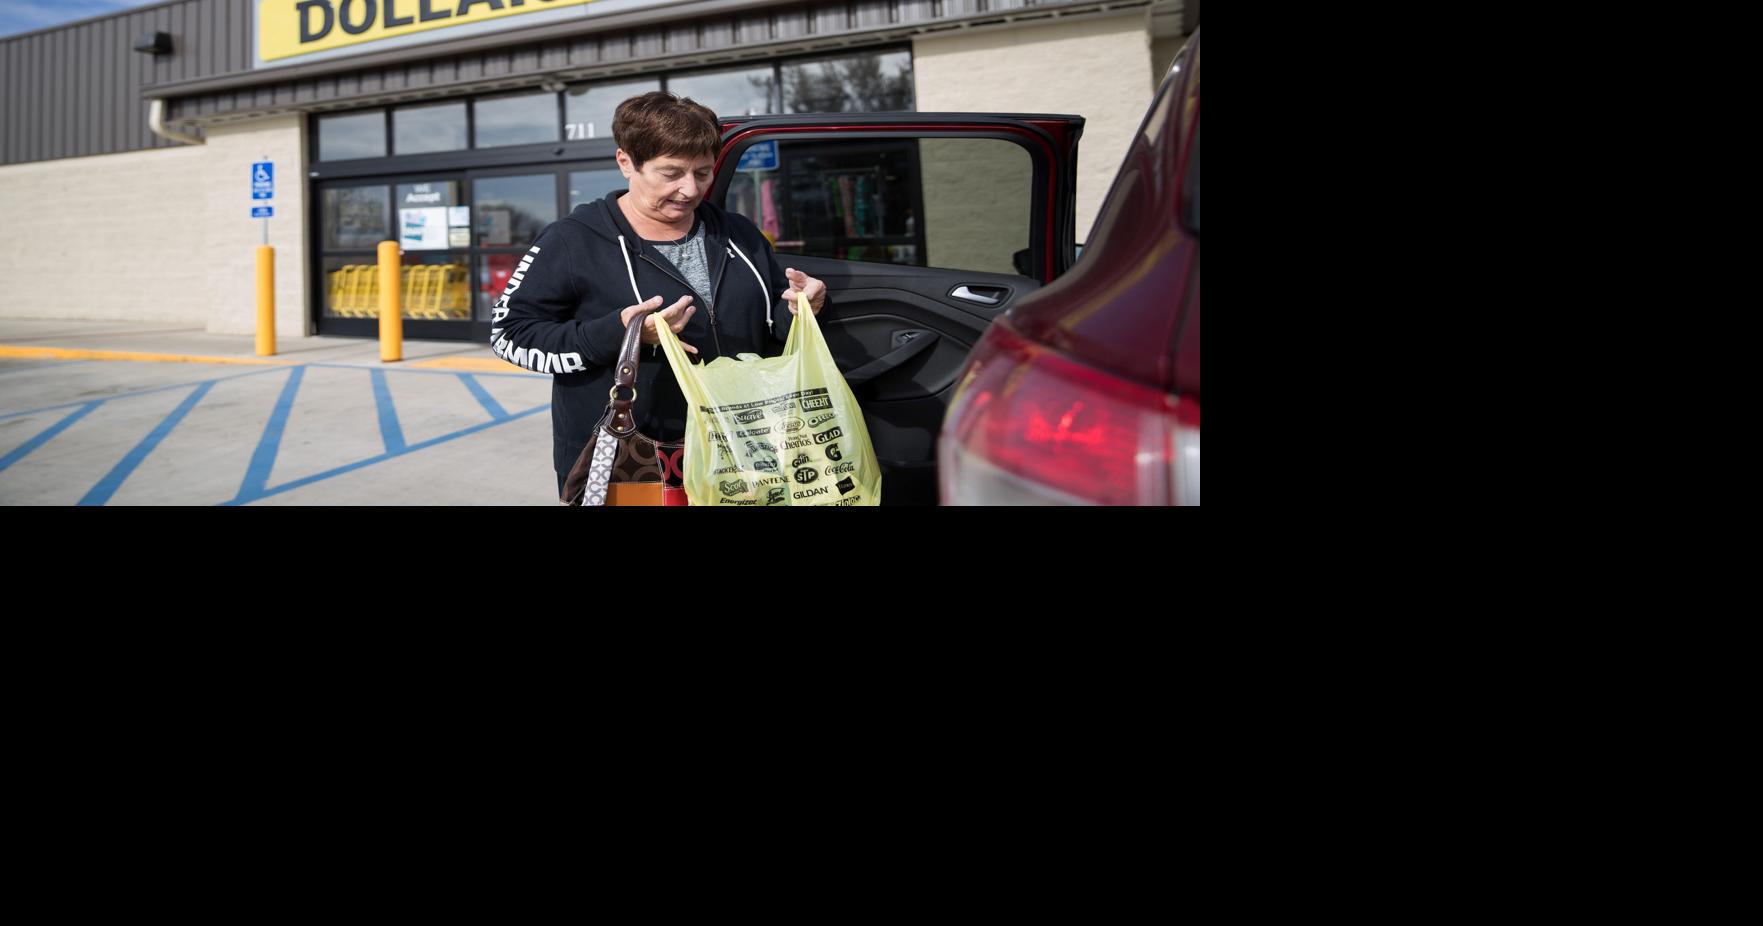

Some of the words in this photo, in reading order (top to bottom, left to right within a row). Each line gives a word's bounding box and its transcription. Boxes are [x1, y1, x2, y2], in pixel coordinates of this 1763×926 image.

[296, 0, 548, 44] DOLL
[565, 123, 595, 140] 711
[815, 429, 841, 443] GLAD
[752, 475, 791, 488] PANTENE
[797, 469, 816, 482] STP
[793, 487, 829, 500] GILDAN
